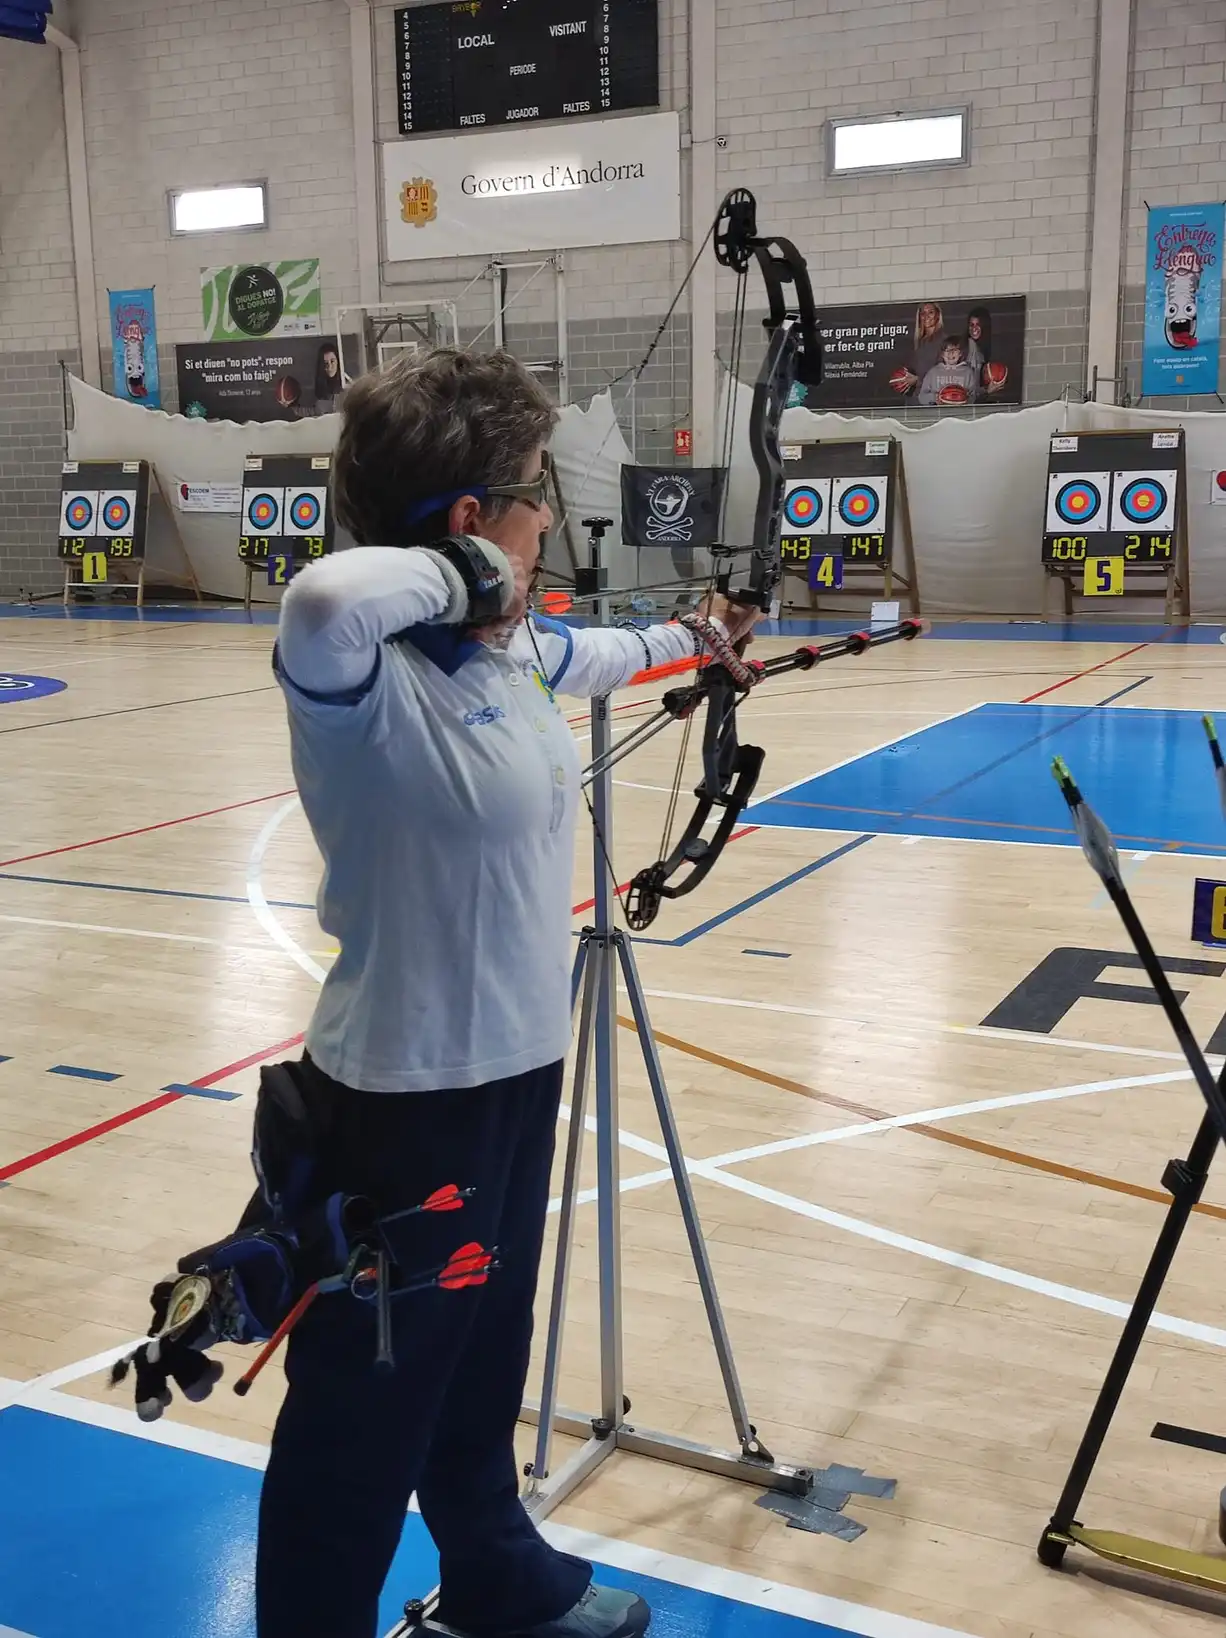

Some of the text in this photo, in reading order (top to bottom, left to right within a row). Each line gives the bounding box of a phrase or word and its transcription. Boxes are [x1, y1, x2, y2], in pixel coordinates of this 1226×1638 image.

[549, 21, 587, 37] VISITANT
[404, 42, 409, 50] 7
[458, 34, 495, 49] LOCAL
[604, 35, 609, 44] 9
[404, 52, 410, 60] 8
[599, 46, 609, 55] 10
[405, 62, 411, 70] 9
[599, 57, 608, 65] 11
[402, 72, 411, 80] 10
[509, 63, 537, 76] PERIODE
[600, 67, 610, 76] 12
[402, 82, 410, 90] 11
[600, 77, 610, 86] 13
[402, 92, 412, 100] 12
[600, 88, 610, 97] 14
[403, 102, 412, 110] 13
[562, 101, 590, 113] FALTES
[601, 99, 610, 107] 15
[403, 112, 412, 120] 14
[460, 113, 486, 125] FALTES
[506, 107, 539, 120] JUGADOR
[404, 122, 412, 130] 15
[461, 160, 645, 196] Govern d'Andorra
[235, 288, 276, 304] DIGUES NO!
[820, 324, 909, 339] er gran per jugar,
[838, 340, 865, 352] fer-te
[867, 338, 895, 352] gran!
[185, 359, 194, 369] Si
[195, 359, 203, 369] et
[204, 359, 226, 369] diuen
[265, 356, 293, 367] respon
[224, 373, 241, 381] com
[243, 371, 252, 380] ho
[63, 537, 86, 556] 112
[110, 537, 133, 556] 193
[304, 536, 324, 556] 73
[781, 536, 810, 560] 143
[852, 535, 883, 555] 147
[1052, 536, 1087, 560] 100
[91, 555, 98, 579] 1
[275, 556, 286, 583] 2
[817, 556, 834, 587] 4
[1097, 560, 1111, 592] 5
[979, 947, 1226, 1055] F
